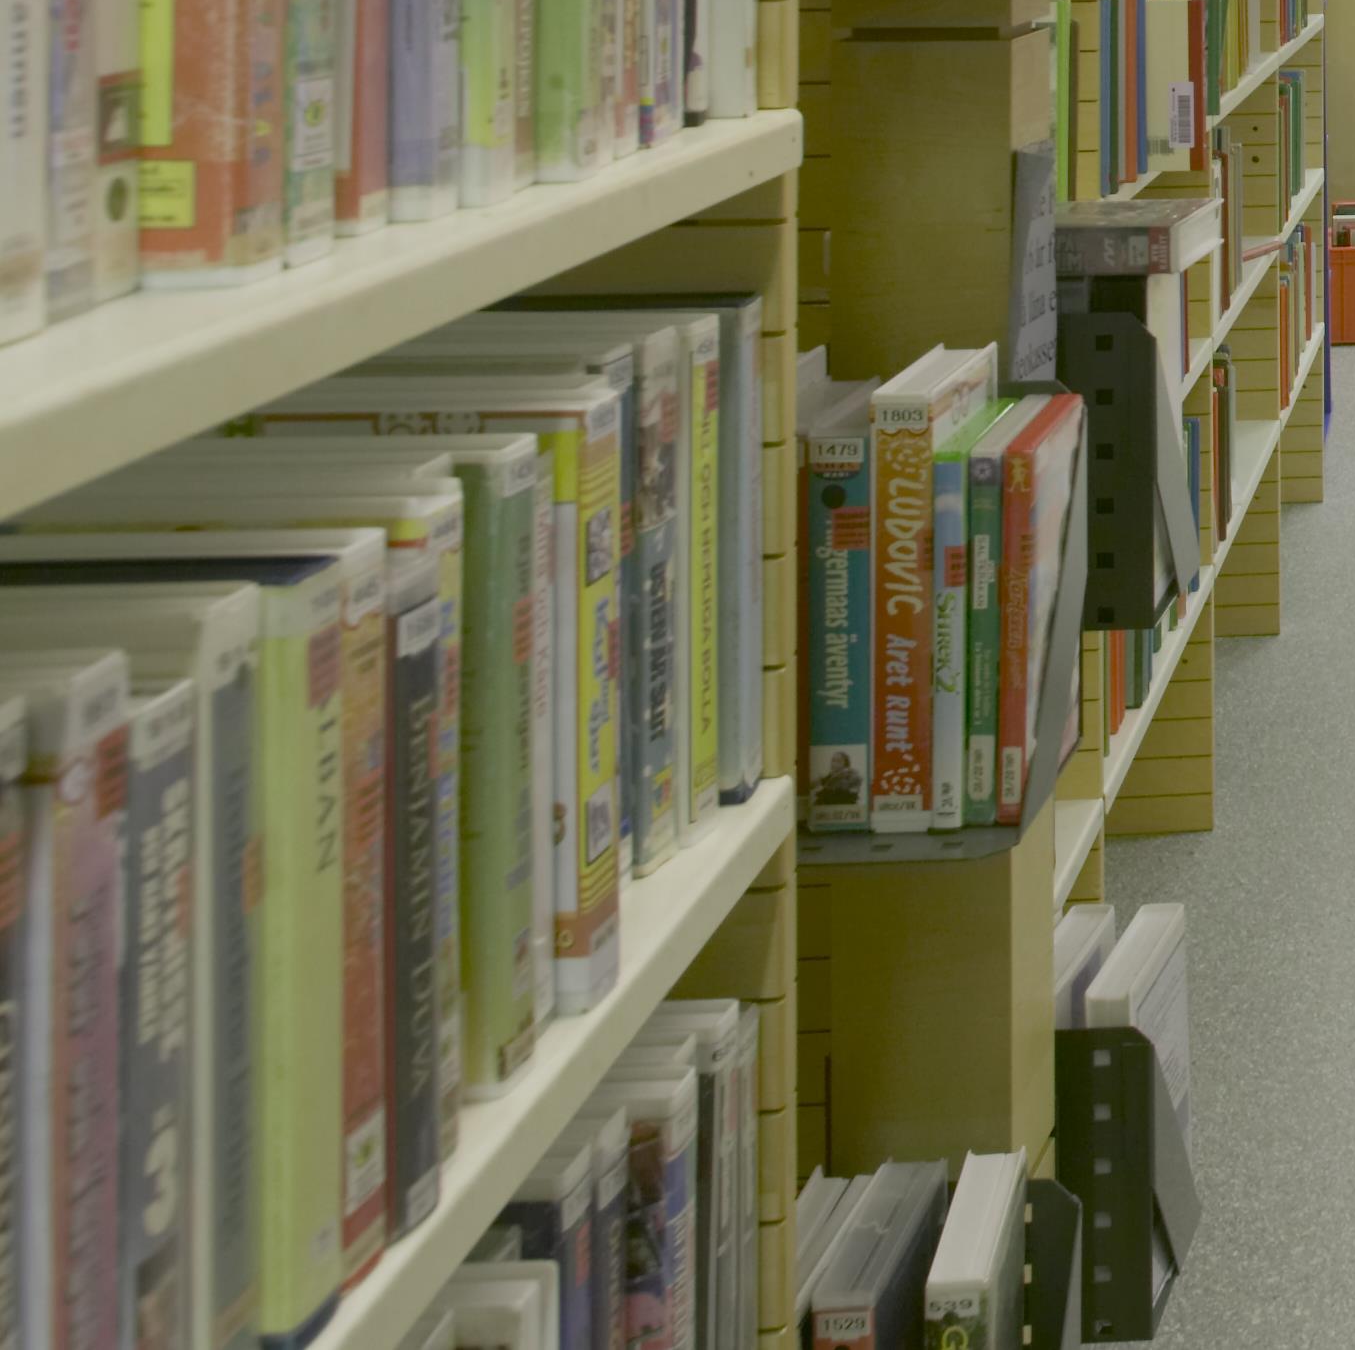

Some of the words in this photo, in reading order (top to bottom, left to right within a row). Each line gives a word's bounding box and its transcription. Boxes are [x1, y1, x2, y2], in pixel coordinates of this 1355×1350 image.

[881, 409, 924, 423] 1803
[815, 443, 858, 457] 1479
[884, 472, 925, 617] LUDOVIC
[701, 526, 713, 642] HEMLIGA
[701, 648, 713, 736] BOLLA
[815, 633, 857, 708] äventyr
[935, 665, 960, 695] 2
[317, 691, 338, 874] LBAN
[822, 1317, 867, 1333] 1529
[928, 1298, 973, 1315] 539
